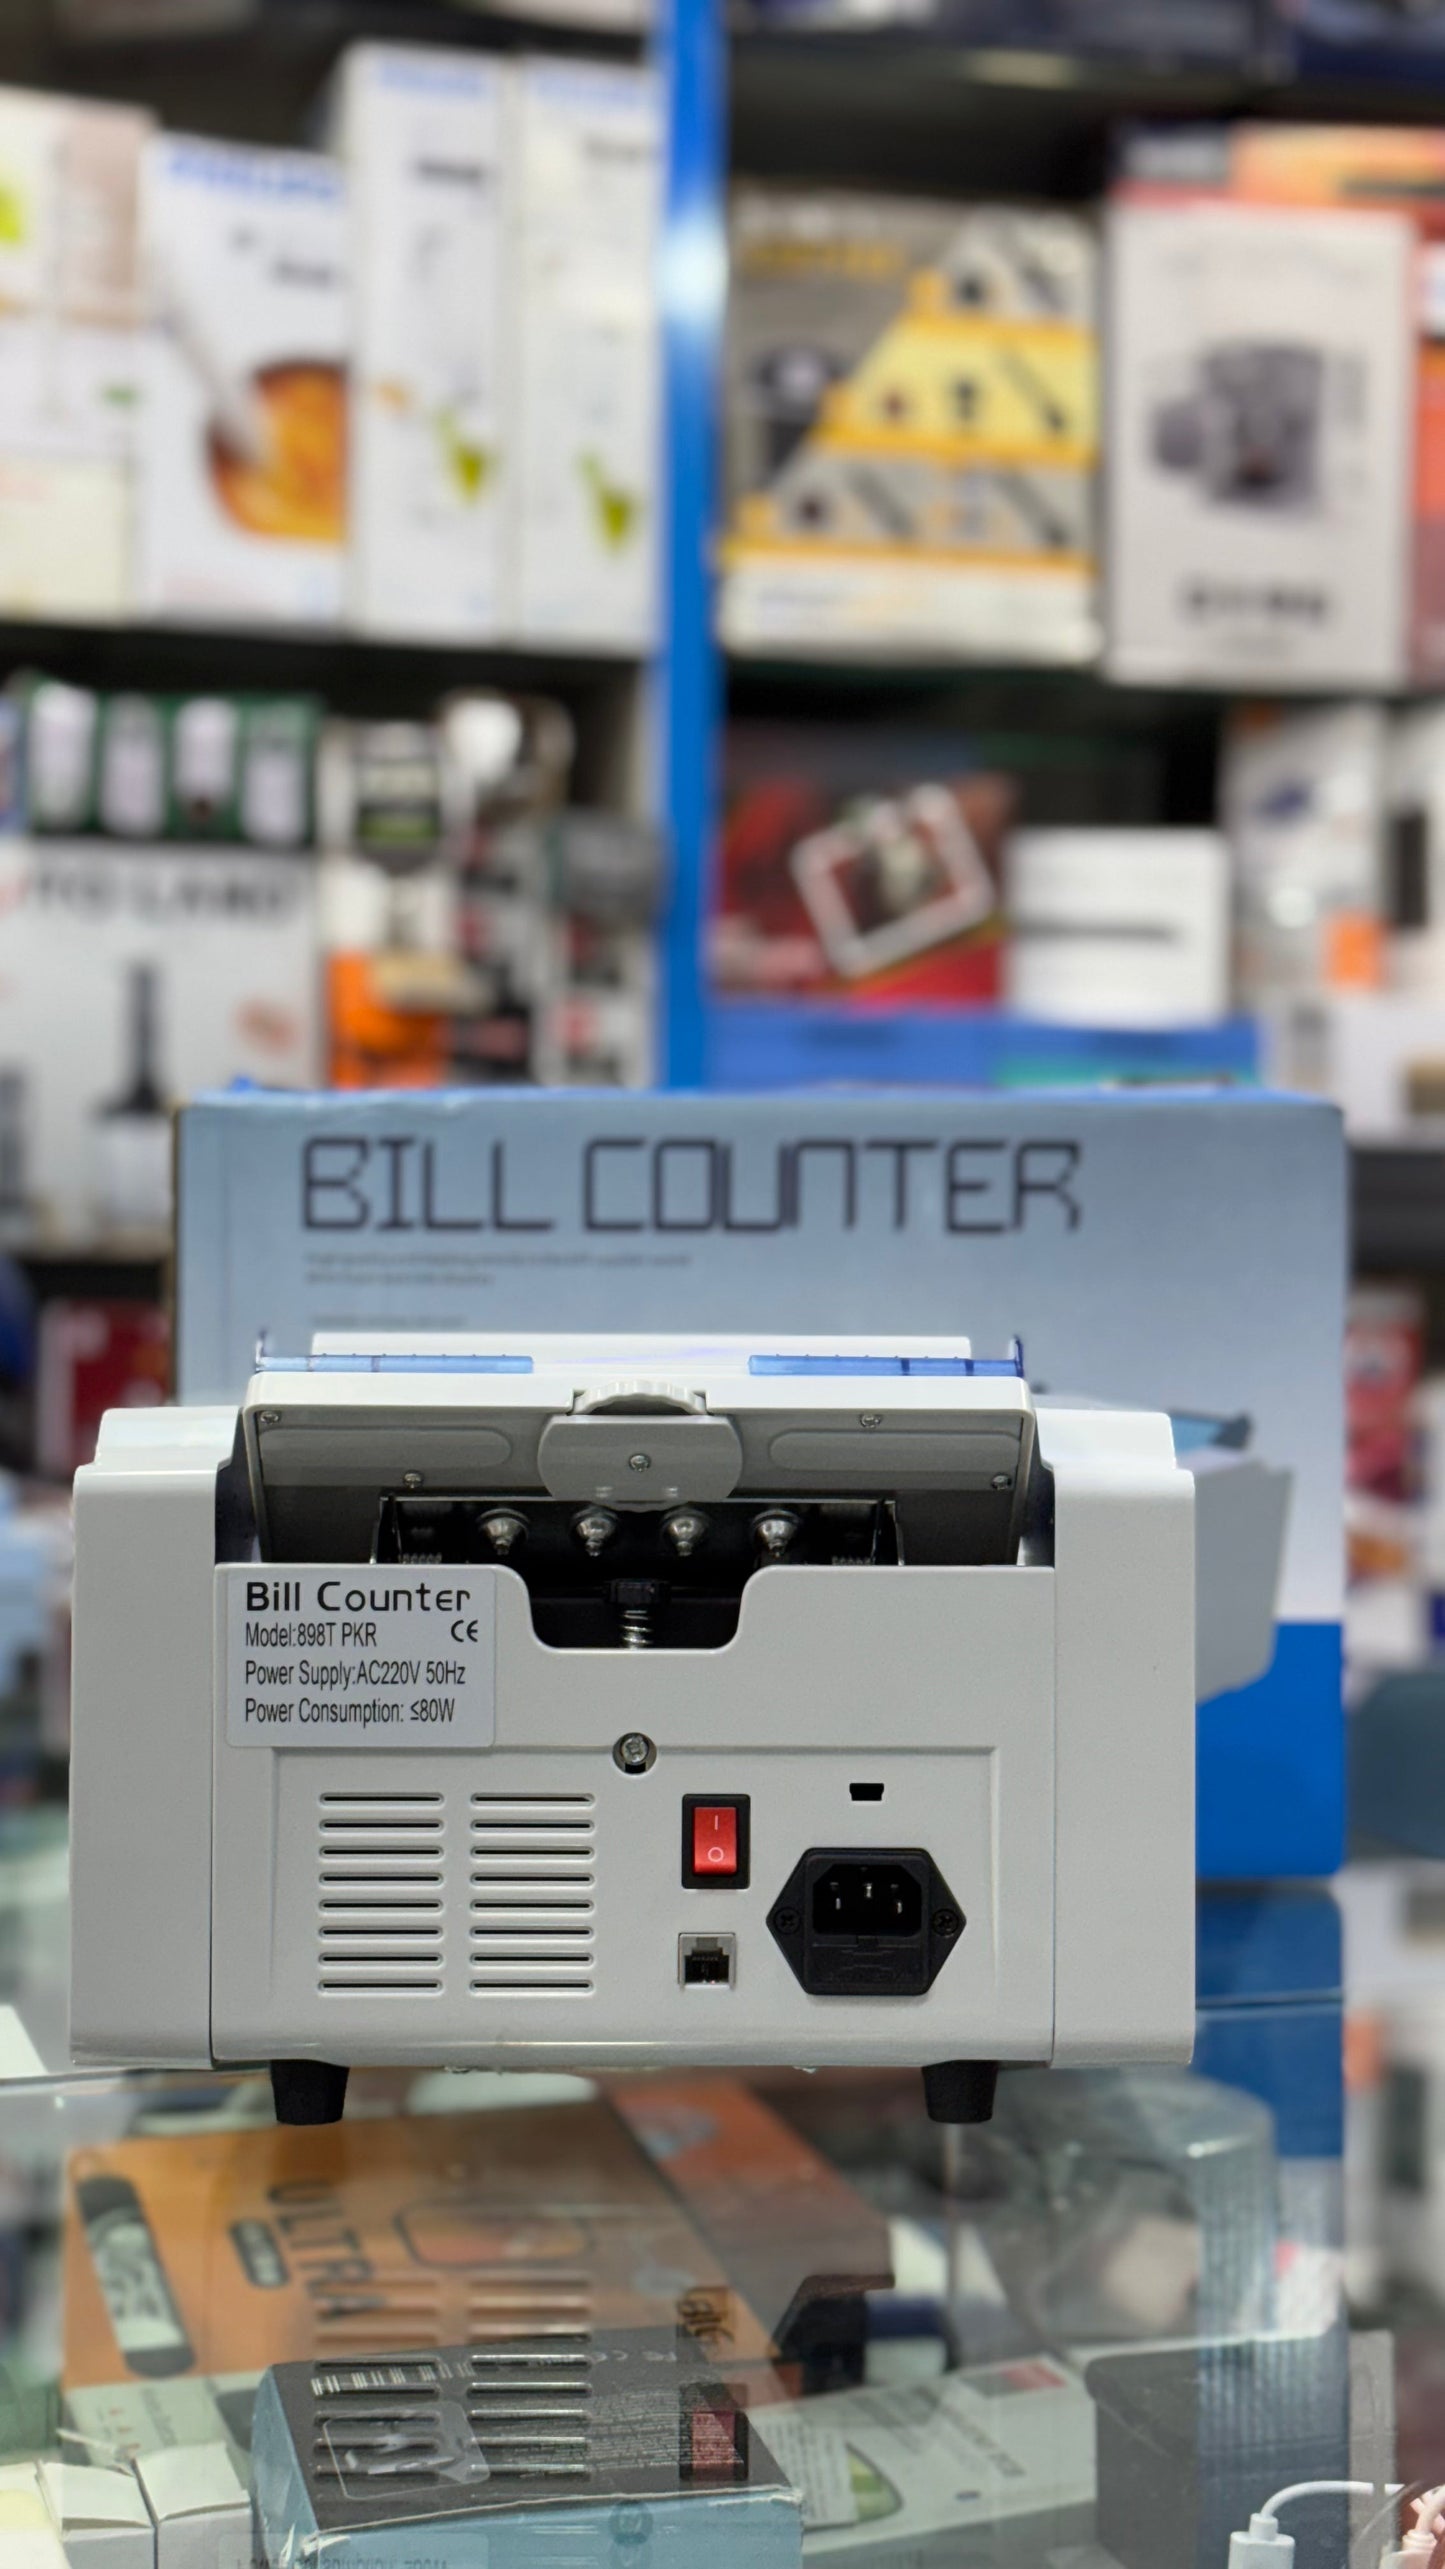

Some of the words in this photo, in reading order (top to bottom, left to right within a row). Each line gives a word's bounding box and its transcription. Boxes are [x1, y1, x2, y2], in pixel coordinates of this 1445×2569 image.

[303, 1135, 556, 1233] BILL
[582, 1136, 1083, 1236] COUNTER
[246, 1581, 301, 1612] Bill
[317, 1581, 471, 1612] Counter
[245, 1622, 337, 1647] Model:898T
[341, 1622, 377, 1647] PKR
[245, 1659, 295, 1685] Power
[298, 1659, 421, 1691] Supply:AC220V
[425, 1660, 466, 1685] 50Hz
[245, 1698, 295, 1723] Power
[298, 1697, 404, 1729] Consumption:
[410, 1698, 455, 1723] ≤80W
